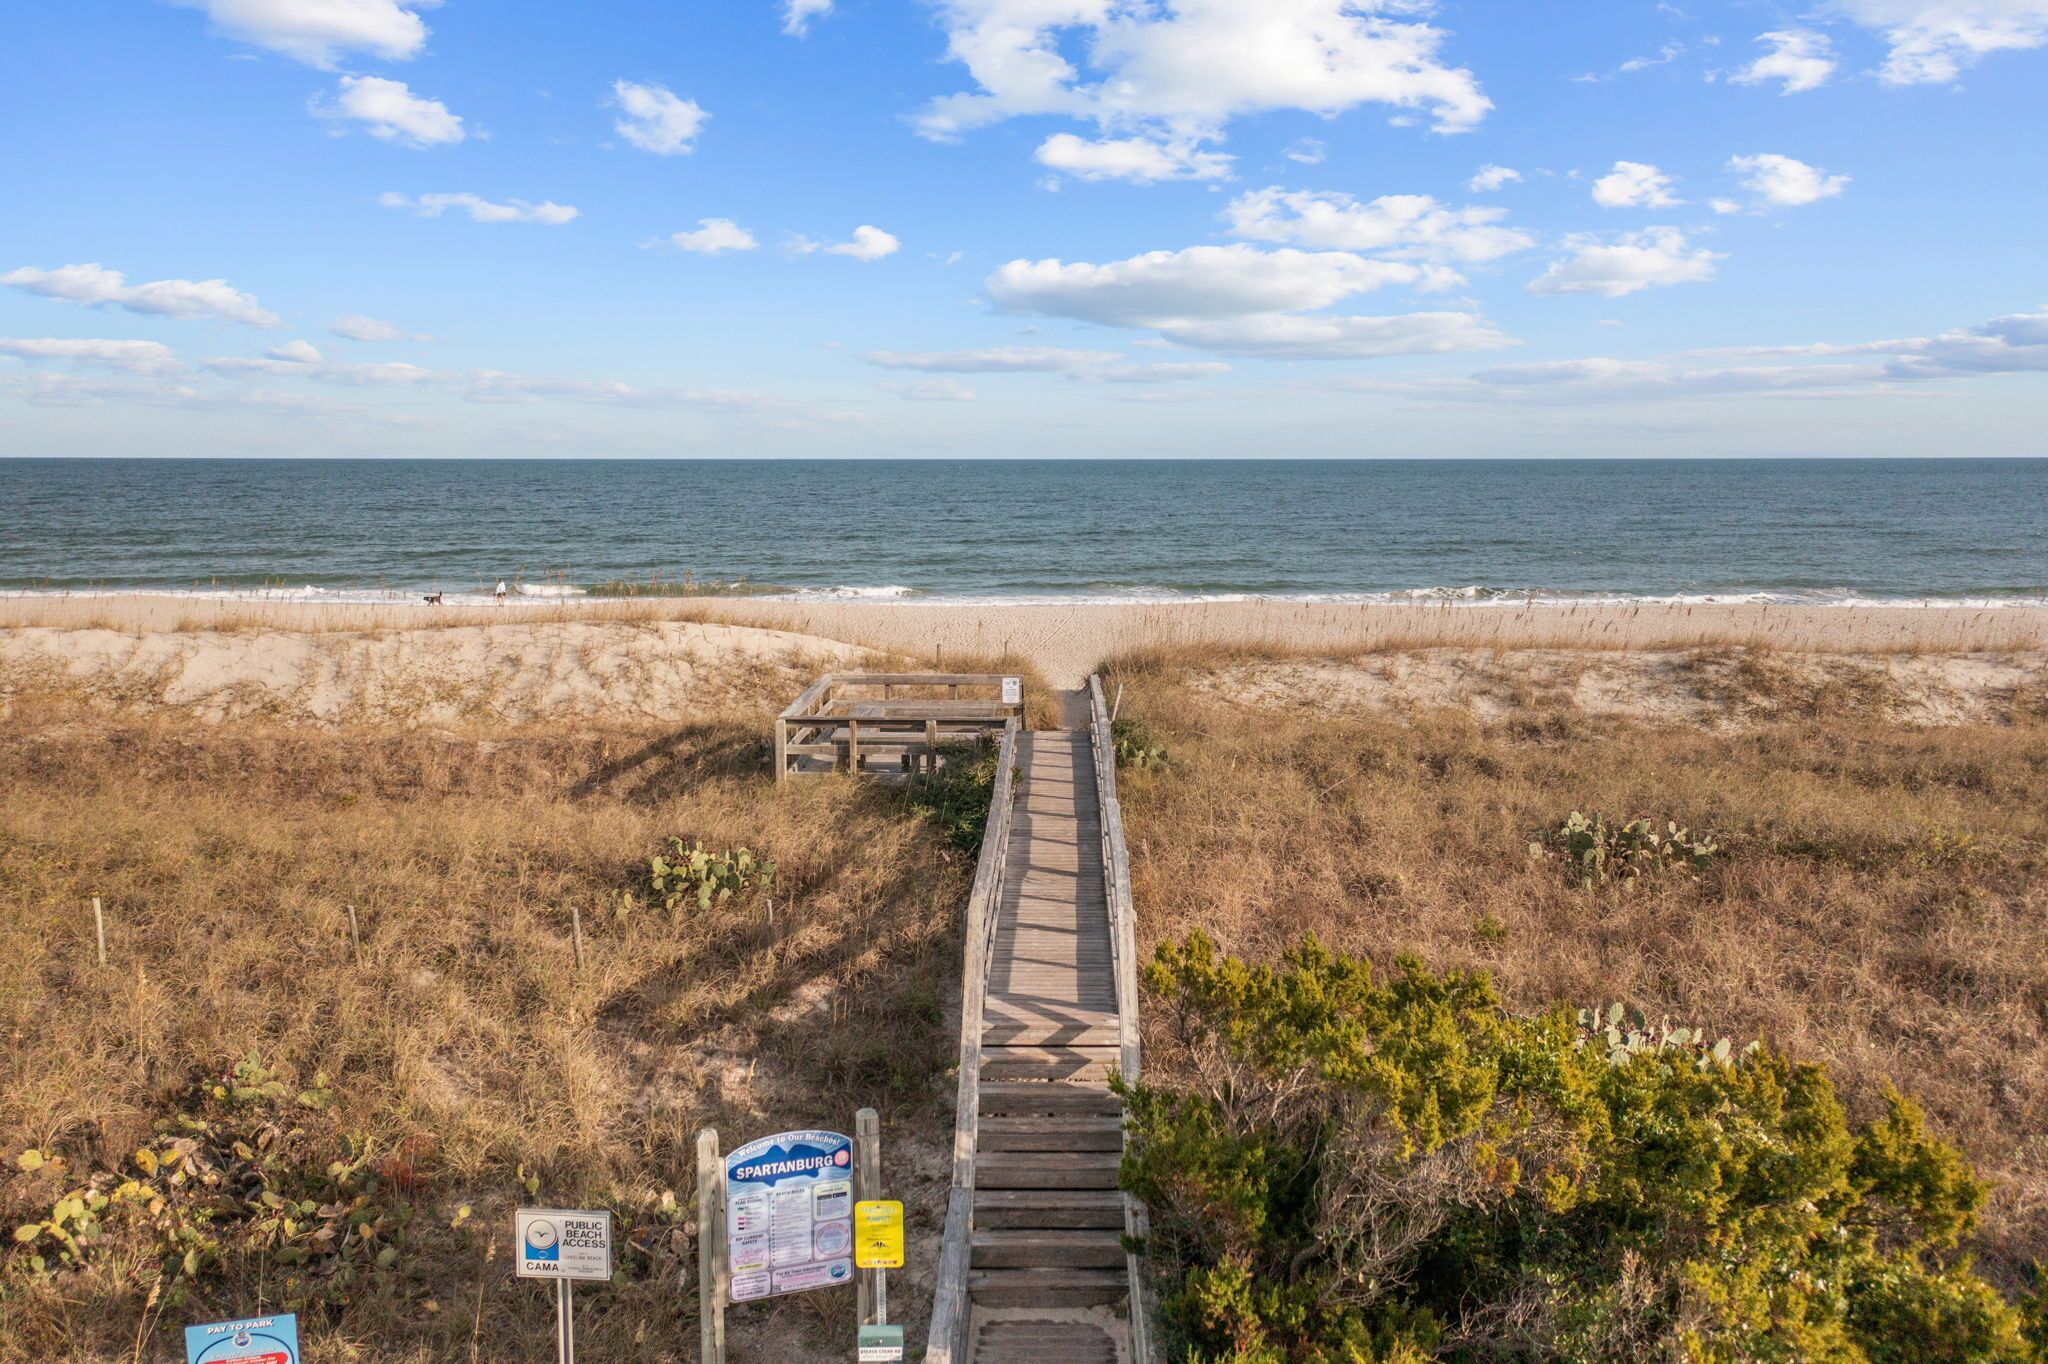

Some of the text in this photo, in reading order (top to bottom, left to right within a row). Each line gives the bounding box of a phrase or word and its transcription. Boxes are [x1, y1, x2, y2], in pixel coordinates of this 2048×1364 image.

[738, 1133, 841, 1157] Welcome to Our Beaches!
[736, 1155, 834, 1179] SPARTANBURG
[564, 1220, 602, 1230] PUBLIC
[565, 1229, 602, 1239] BEACH
[743, 1233, 764, 1241] CURRENT
[562, 1238, 606, 1249] ACCESS
[526, 1262, 559, 1272] CAMA
[207, 1319, 274, 1335] PAY TO PARK
